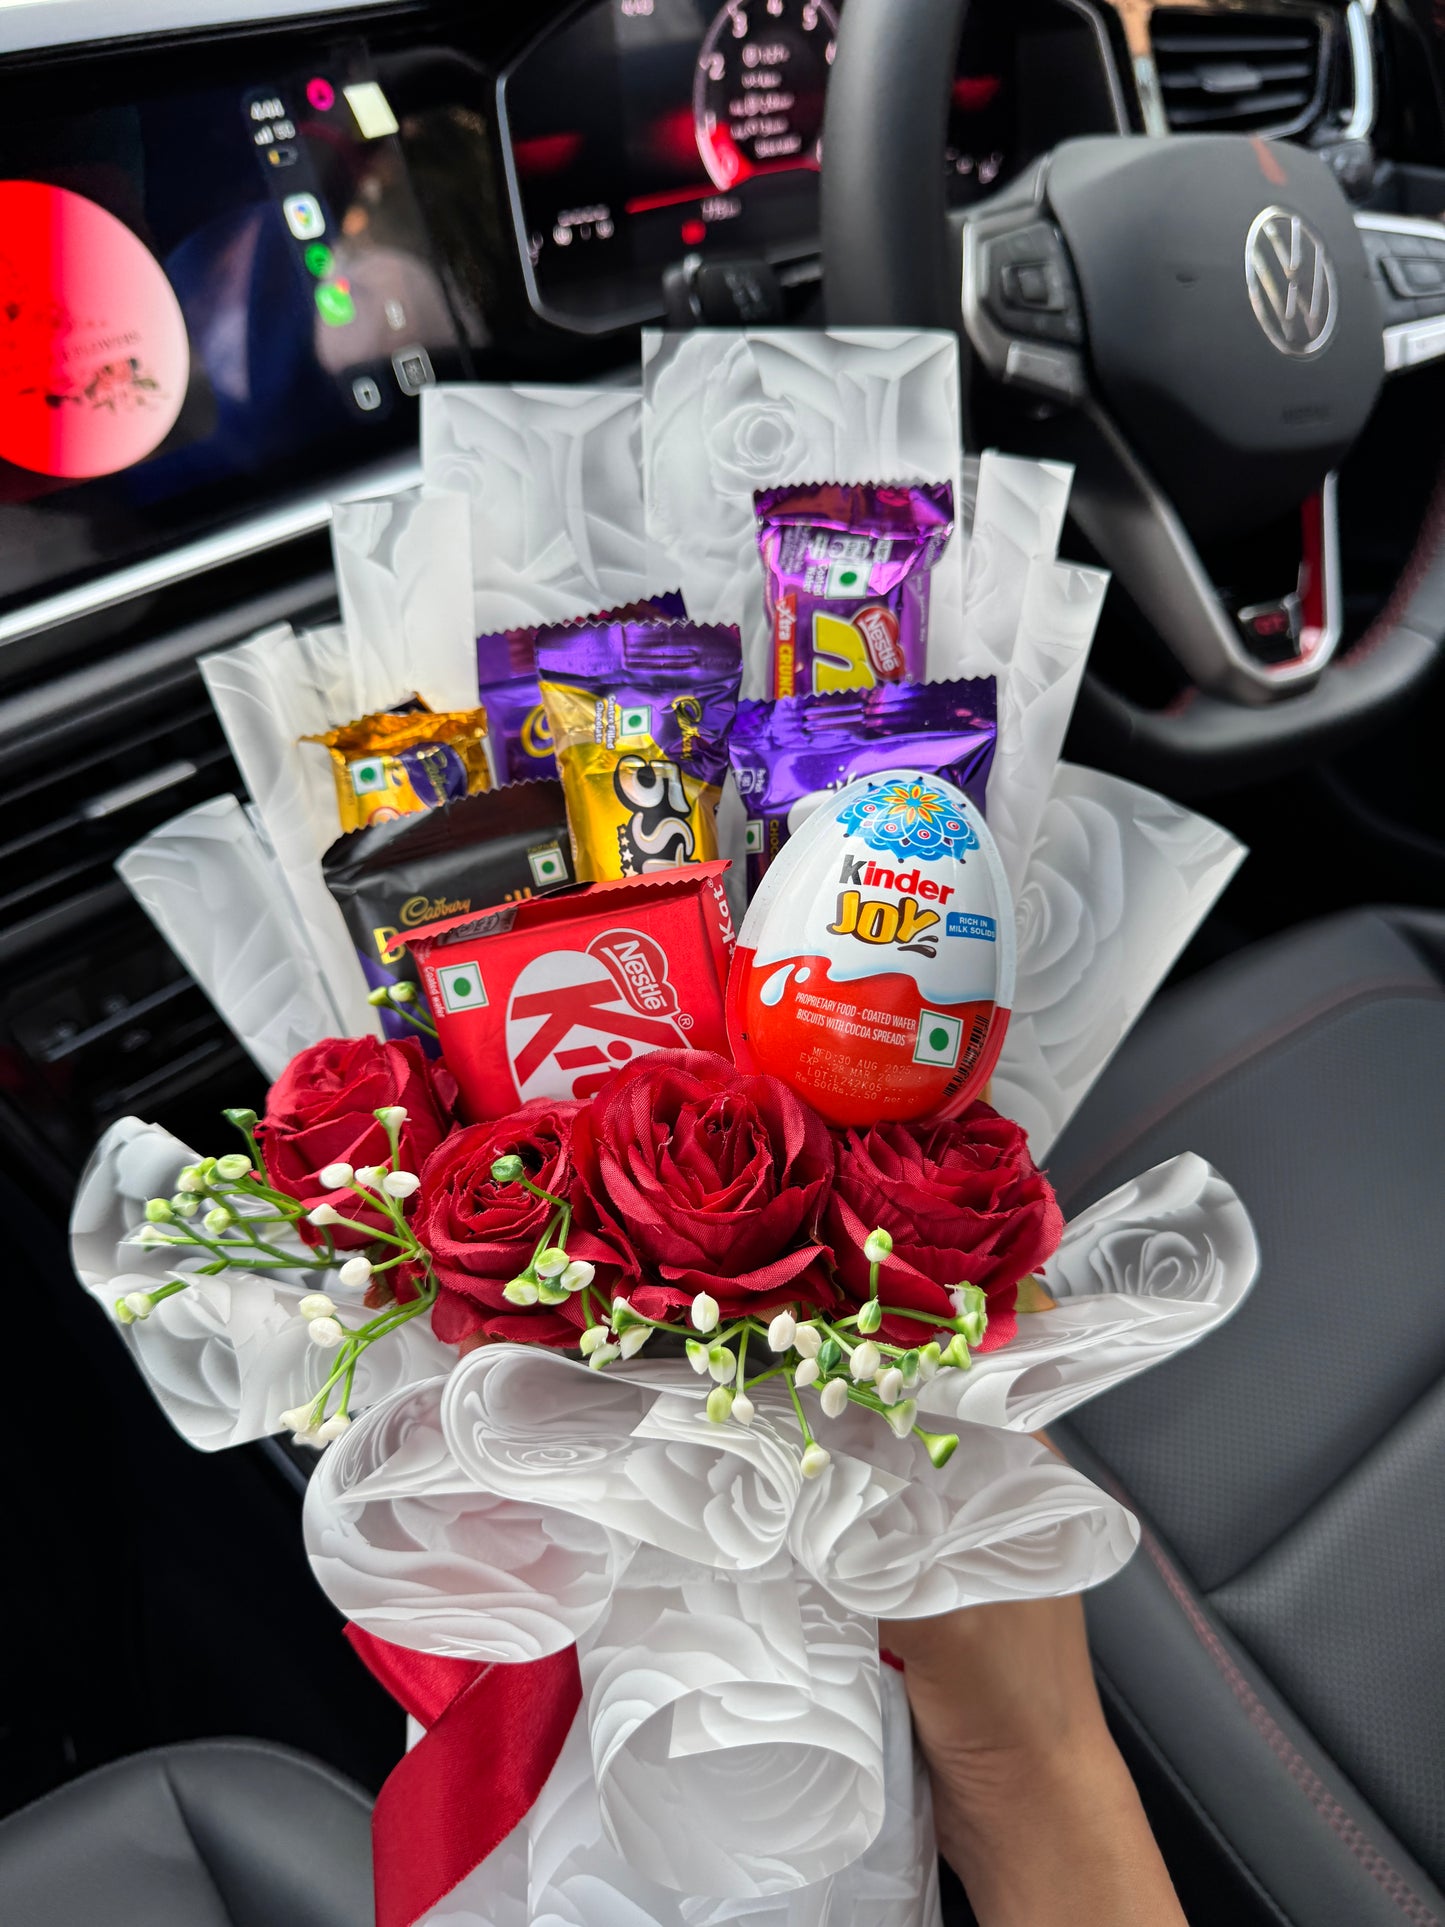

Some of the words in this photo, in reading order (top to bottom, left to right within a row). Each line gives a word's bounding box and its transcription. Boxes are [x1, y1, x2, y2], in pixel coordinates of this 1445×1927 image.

[778, 644, 794, 698] CRUNC
[400, 896, 472, 927] Cadbury
[959, 916, 979, 926] RICH
[949, 926, 969, 934] MILK
[970, 928, 996, 938] SOLIDS
[795, 992, 837, 1011] PROPRIETARY
[836, 1002, 857, 1017] FOOD
[861, 1008, 891, 1026] COATED
[892, 1014, 917, 1031] WAFER
[796, 1008, 826, 1027] BISCUITS
[826, 1017, 844, 1031] WITH
[844, 1021, 871, 1039] COCOA
[872, 1028, 906, 1046] SPREADS
[849, 1067, 871, 1079] MAR
[856, 1059, 878, 1071] AUG
